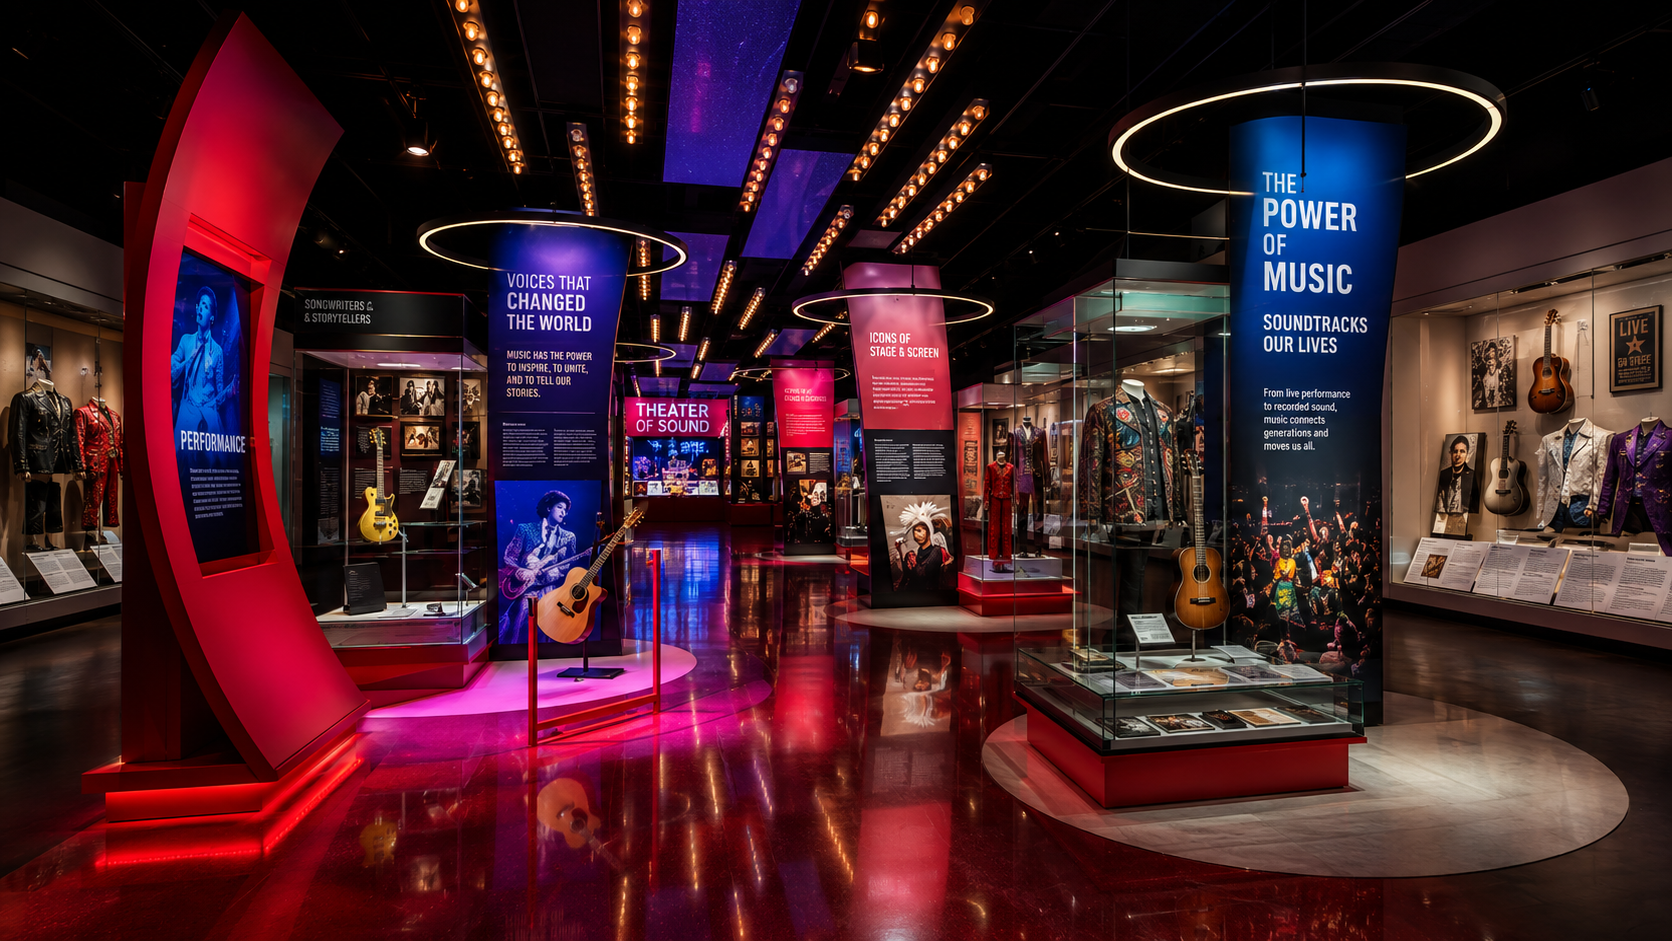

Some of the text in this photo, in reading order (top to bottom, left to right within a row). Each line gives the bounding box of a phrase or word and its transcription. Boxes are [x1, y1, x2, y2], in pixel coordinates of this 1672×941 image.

[1262, 172, 1297, 194] THE
[1263, 198, 1357, 232] POWER
[1263, 232, 1286, 256] OF
[506, 272, 592, 290] VOICES THAT
[1264, 261, 1352, 294] MUSIC
[304, 298, 364, 311] SONGWRITERS
[506, 292, 586, 312] CHANGED
[304, 312, 371, 324] & STORYTELLERS
[506, 314, 592, 332] THE WORLD
[1263, 314, 1368, 334] SOUNDTRACKS
[1620, 318, 1649, 336] LIVE
[870, 332, 911, 344] ICONS OF
[1263, 335, 1337, 353] OUR LIVES
[506, 350, 592, 361] MUSIC HAS THE POWER
[870, 346, 939, 358] STAGE & SCREEN
[506, 362, 517, 372] TO
[552, 363, 562, 373] TO
[506, 376, 571, 386] AND TO TELL OUR
[506, 388, 541, 398] STORIES.
[1264, 388, 1351, 400] From live performance
[636, 402, 709, 418] THEATER
[1264, 402, 1272, 411] to
[1274, 402, 1309, 411] recorded
[636, 419, 710, 433] OF SOUND
[1264, 415, 1326, 424] music connects
[1264, 428, 1328, 439] generations and
[181, 430, 246, 453] PERFORMANCE
[1303, 441, 1315, 450] all.
